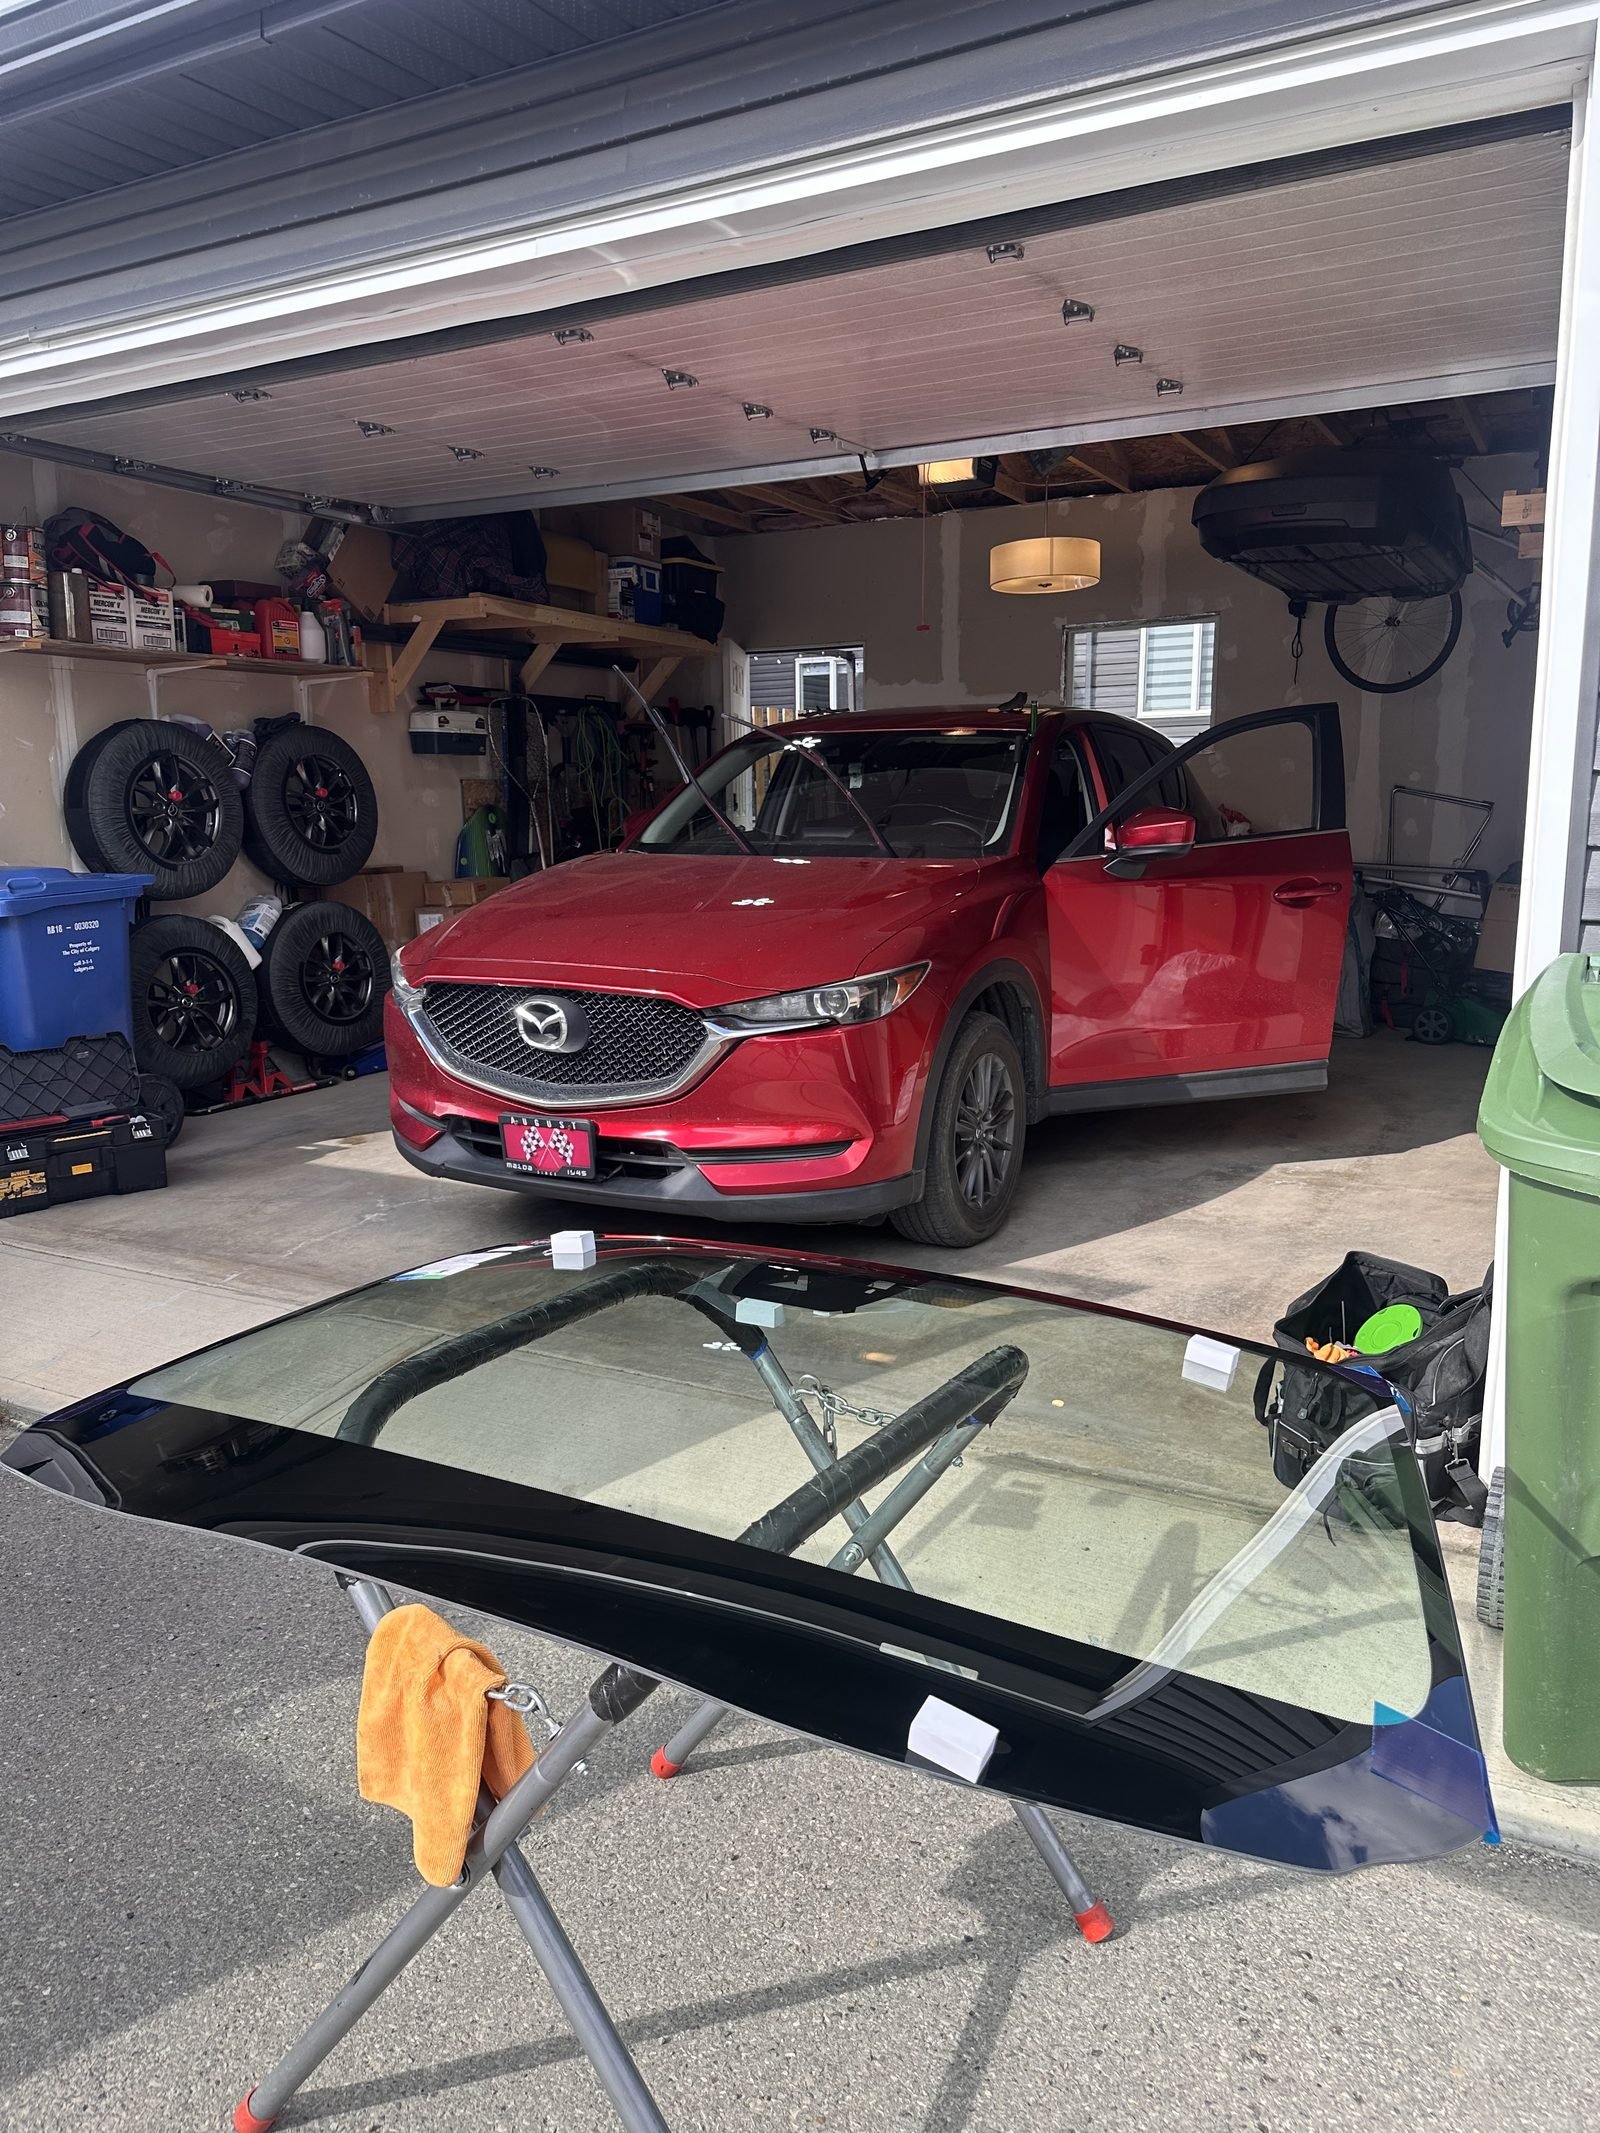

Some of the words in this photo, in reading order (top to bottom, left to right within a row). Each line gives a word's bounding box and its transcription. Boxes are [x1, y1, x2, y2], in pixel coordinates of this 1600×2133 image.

[74, 920, 99, 930] 0030320
[510, 1116, 576, 1130] AUGUST
[567, 1169, 587, 1177] 1945
